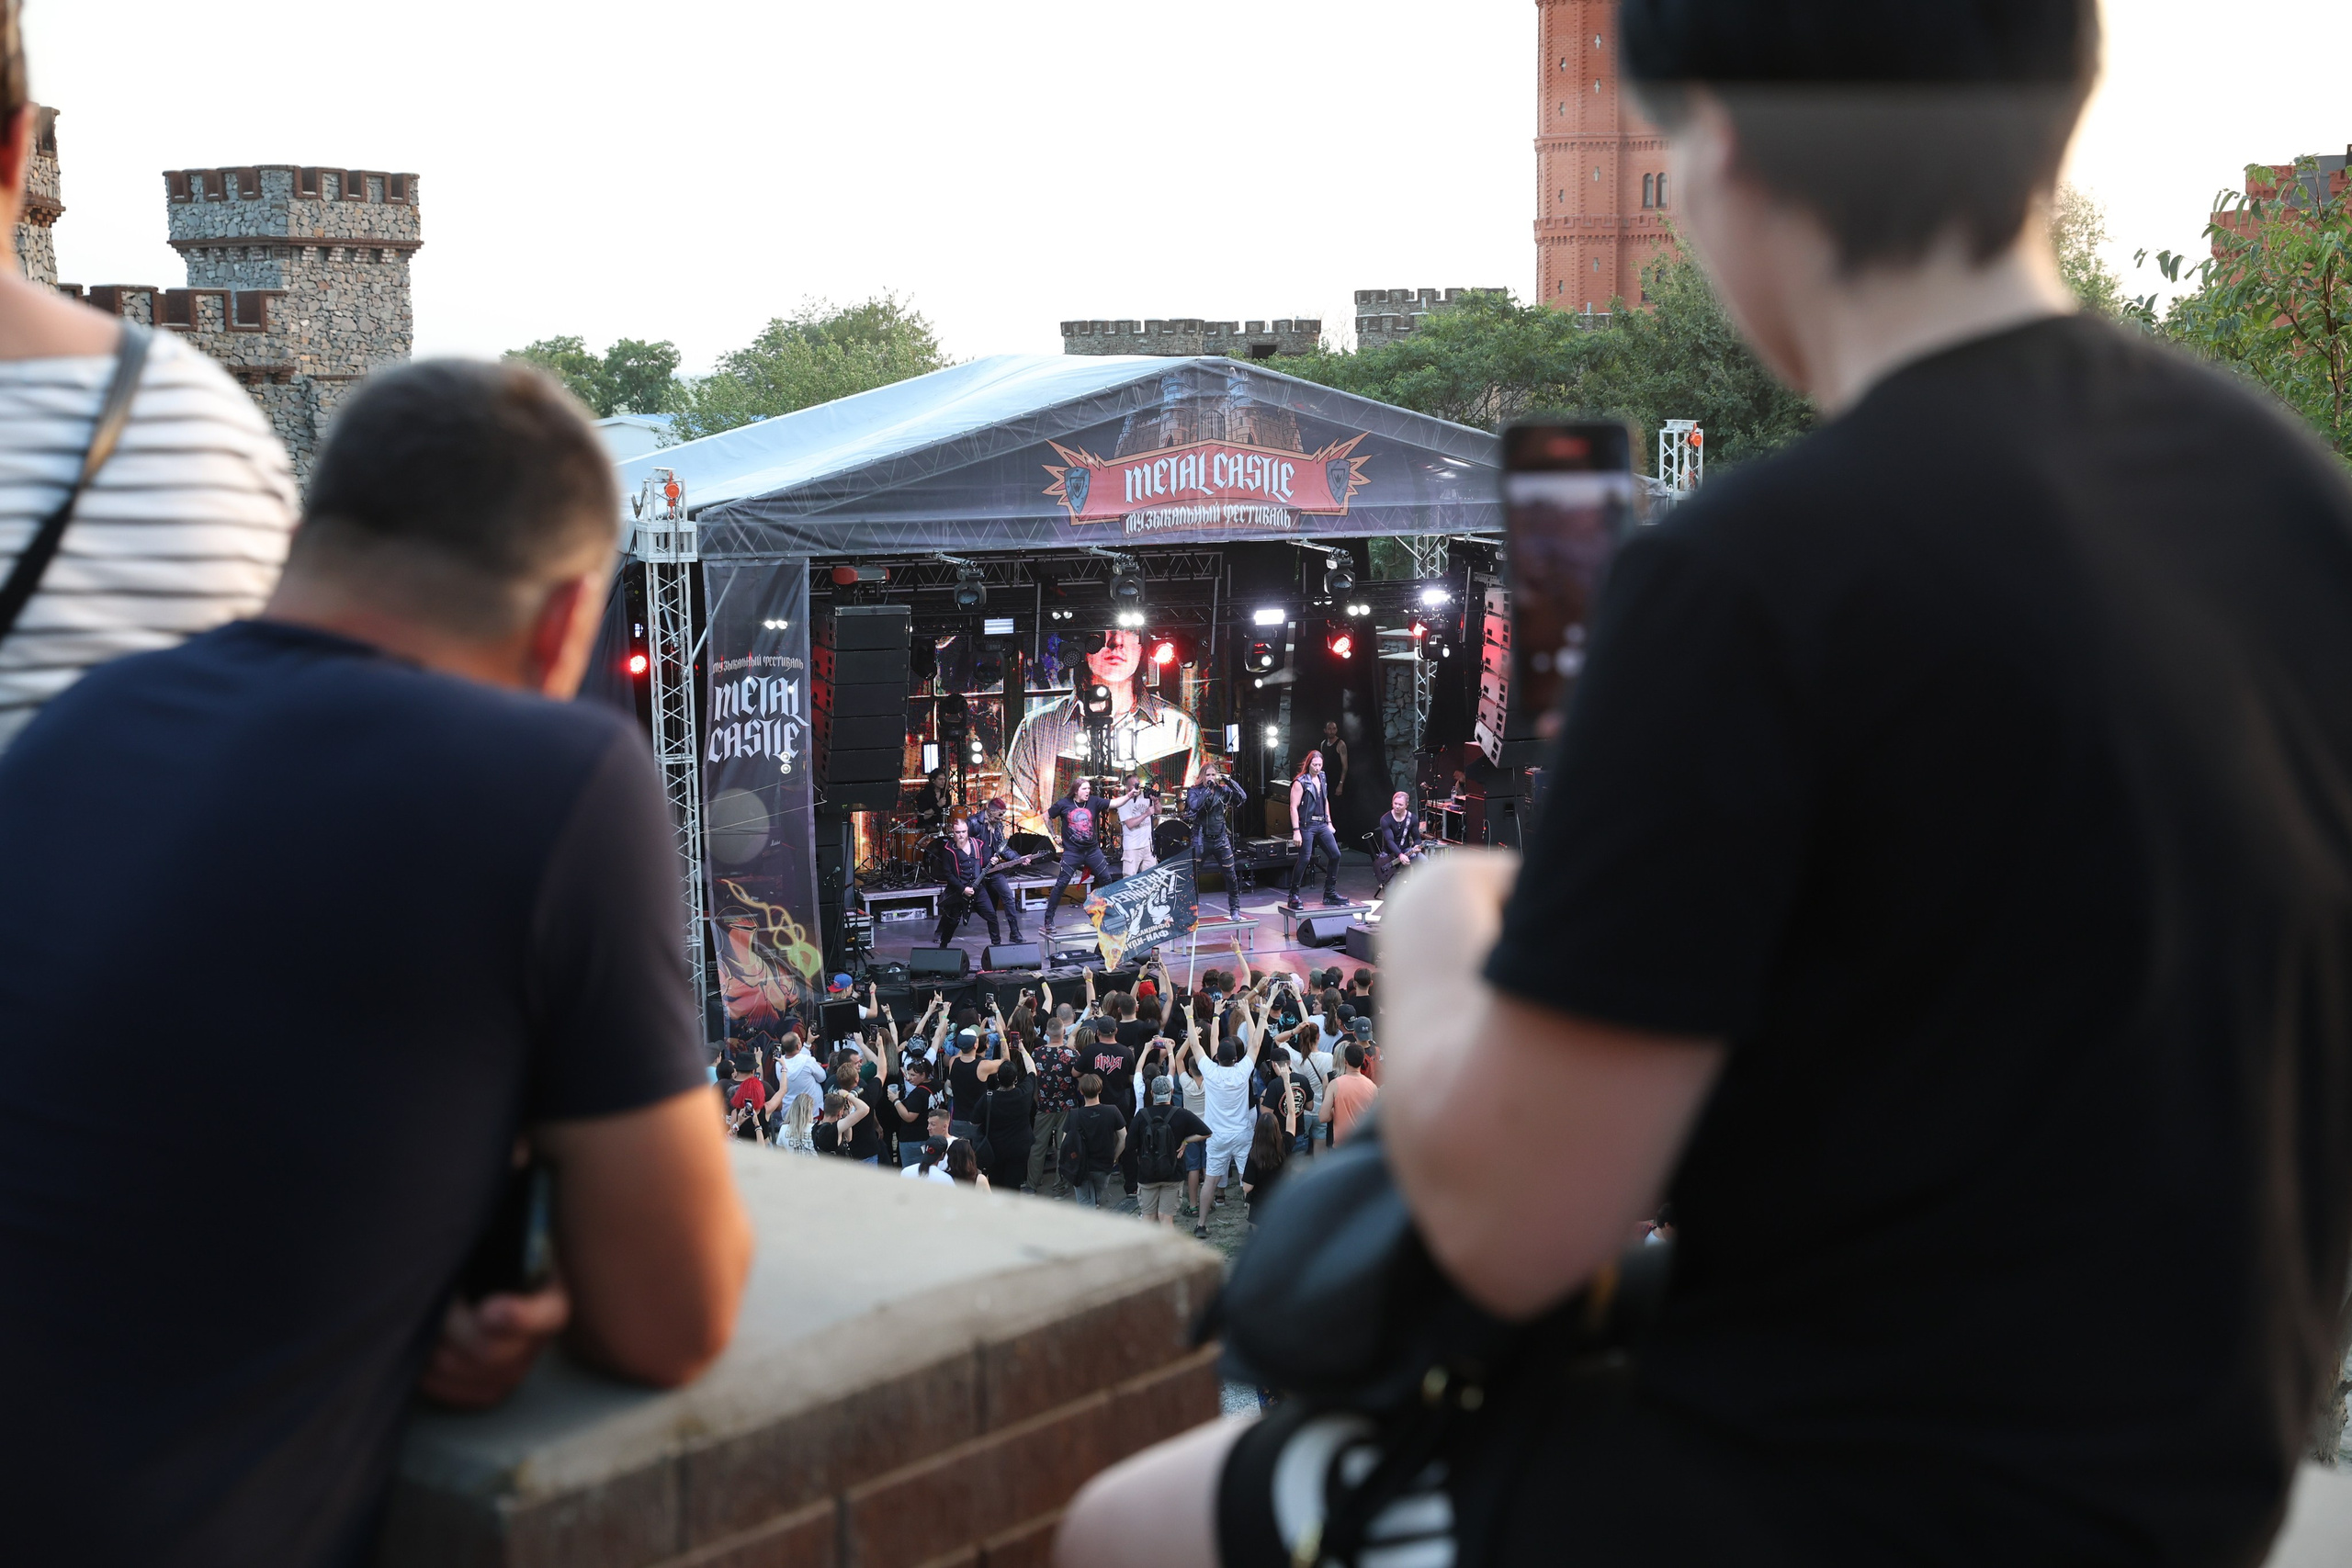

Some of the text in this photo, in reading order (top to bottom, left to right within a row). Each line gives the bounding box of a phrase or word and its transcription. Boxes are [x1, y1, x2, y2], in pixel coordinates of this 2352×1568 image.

[1125, 451, 1295, 503] METAL CASTLE
[1126, 501, 1292, 535] МУЗЫКАЛЬНЫЙ ФЕСТИВАЛЬ
[763, 655, 804, 672] ФЕСТИВАЛЬ
[714, 675, 809, 727] METAL
[707, 717, 800, 763] CASTLE
[1094, 1053, 1124, 1075] АРИЯ
